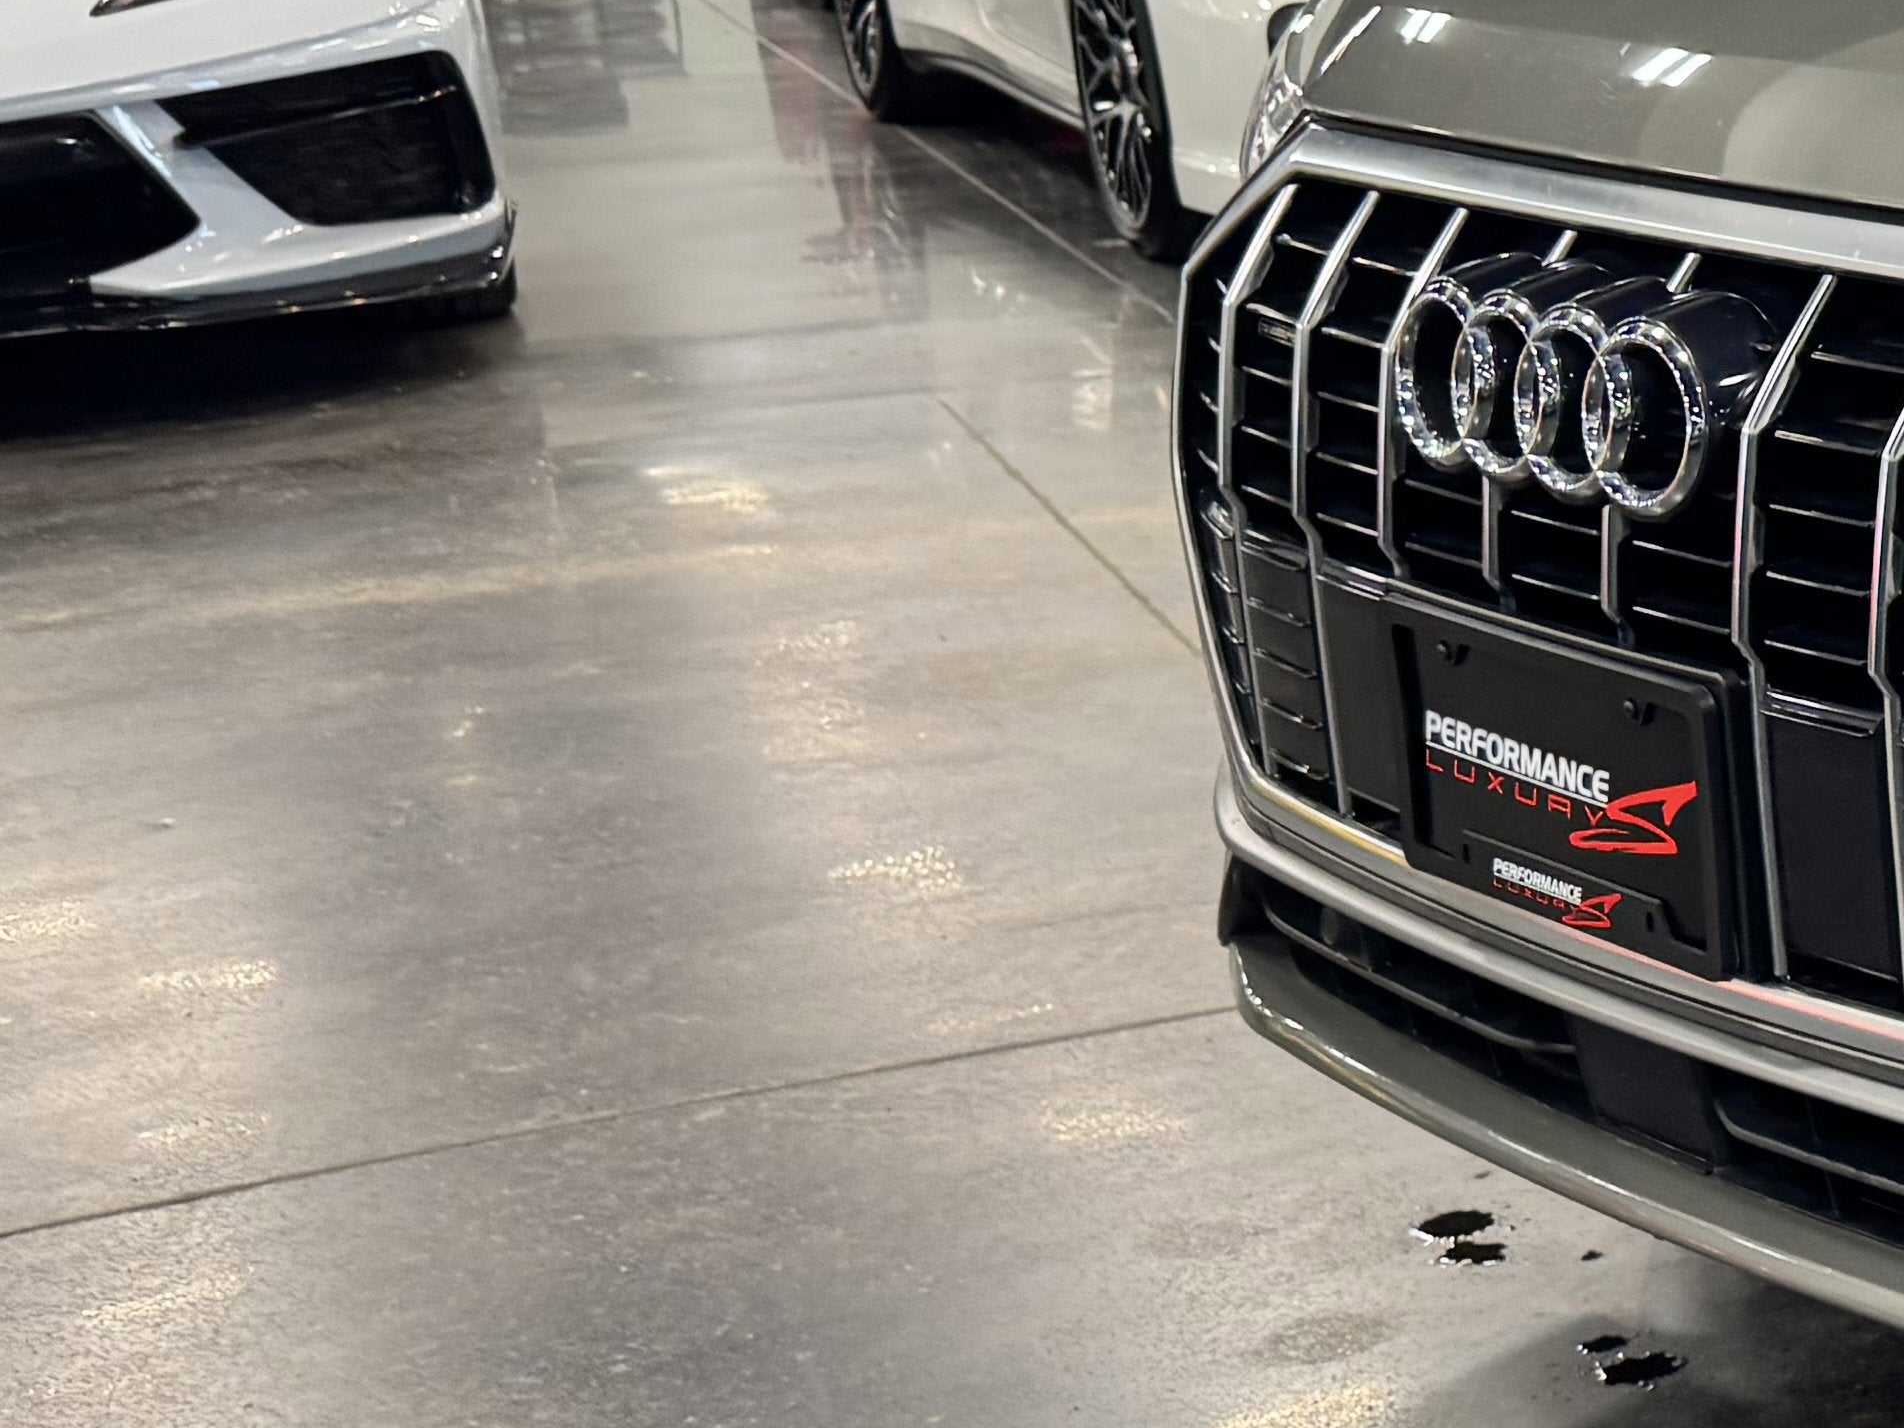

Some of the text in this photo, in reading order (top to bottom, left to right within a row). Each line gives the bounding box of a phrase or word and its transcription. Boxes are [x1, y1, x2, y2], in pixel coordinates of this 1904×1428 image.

[1425, 709, 1610, 803] PERFORMANCE
[1425, 748, 1604, 826] LUXURY
[1492, 857, 1582, 903] PERFORMANCE
